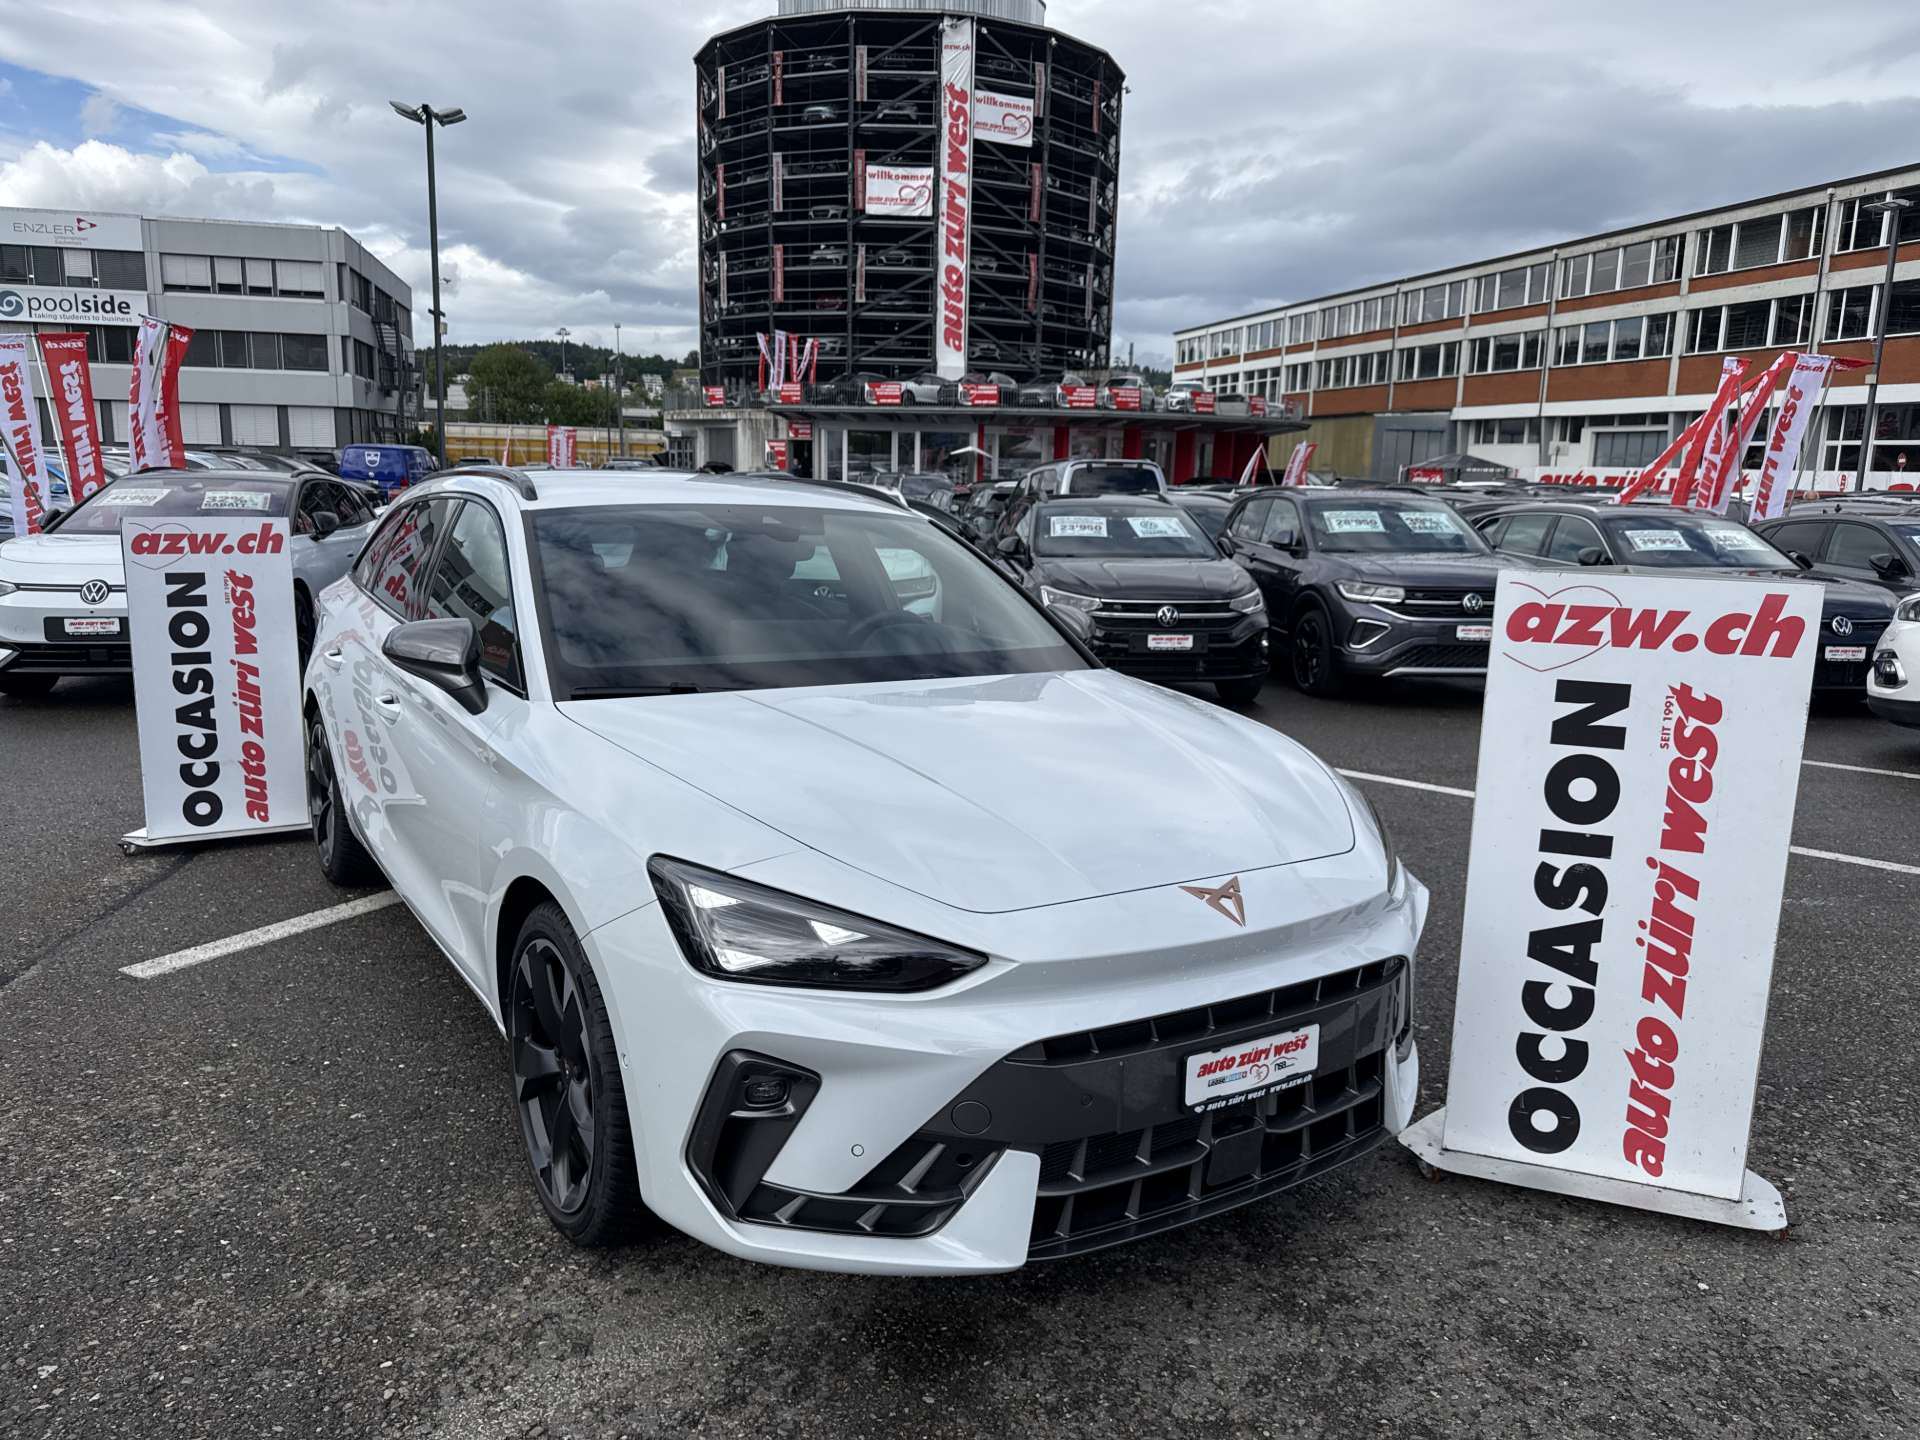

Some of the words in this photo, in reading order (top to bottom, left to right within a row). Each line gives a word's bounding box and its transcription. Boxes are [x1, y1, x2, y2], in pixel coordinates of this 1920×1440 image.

[945, 81, 969, 173] west
[975, 95, 1032, 112] willkommen
[868, 170, 931, 181] willkommen
[13, 222, 75, 235] ENZLER
[941, 176, 967, 264] züri
[27, 292, 131, 318] poolside
[34, 312, 57, 321] taking
[59, 313, 90, 321] students
[101, 314, 133, 323] business
[942, 263, 965, 353] auto
[1770, 384, 1804, 453] west
[130, 522, 284, 555] azw.ch
[223, 569, 260, 655] west
[1505, 593, 1806, 659] azw.ch
[165, 572, 223, 827] OCCASION
[230, 659, 264, 739] züri
[1663, 695, 1675, 721] 1991
[1660, 726, 1671, 750] SEIT
[1660, 682, 1723, 854] west
[237, 740, 270, 823] auto
[1507, 679, 1632, 1154] OCCASION
[1635, 856, 1701, 1021] züri
[1197, 1053, 1237, 1078] auto
[1237, 1043, 1273, 1068] züri
[1273, 1033, 1310, 1058] west
[1207, 1100, 1227, 1111] auto
[1228, 1093, 1246, 1105] züri
[1247, 1088, 1266, 1100] west
[1269, 1074, 1313, 1093] www.azw.ch
[1623, 1015, 1680, 1178] auto
